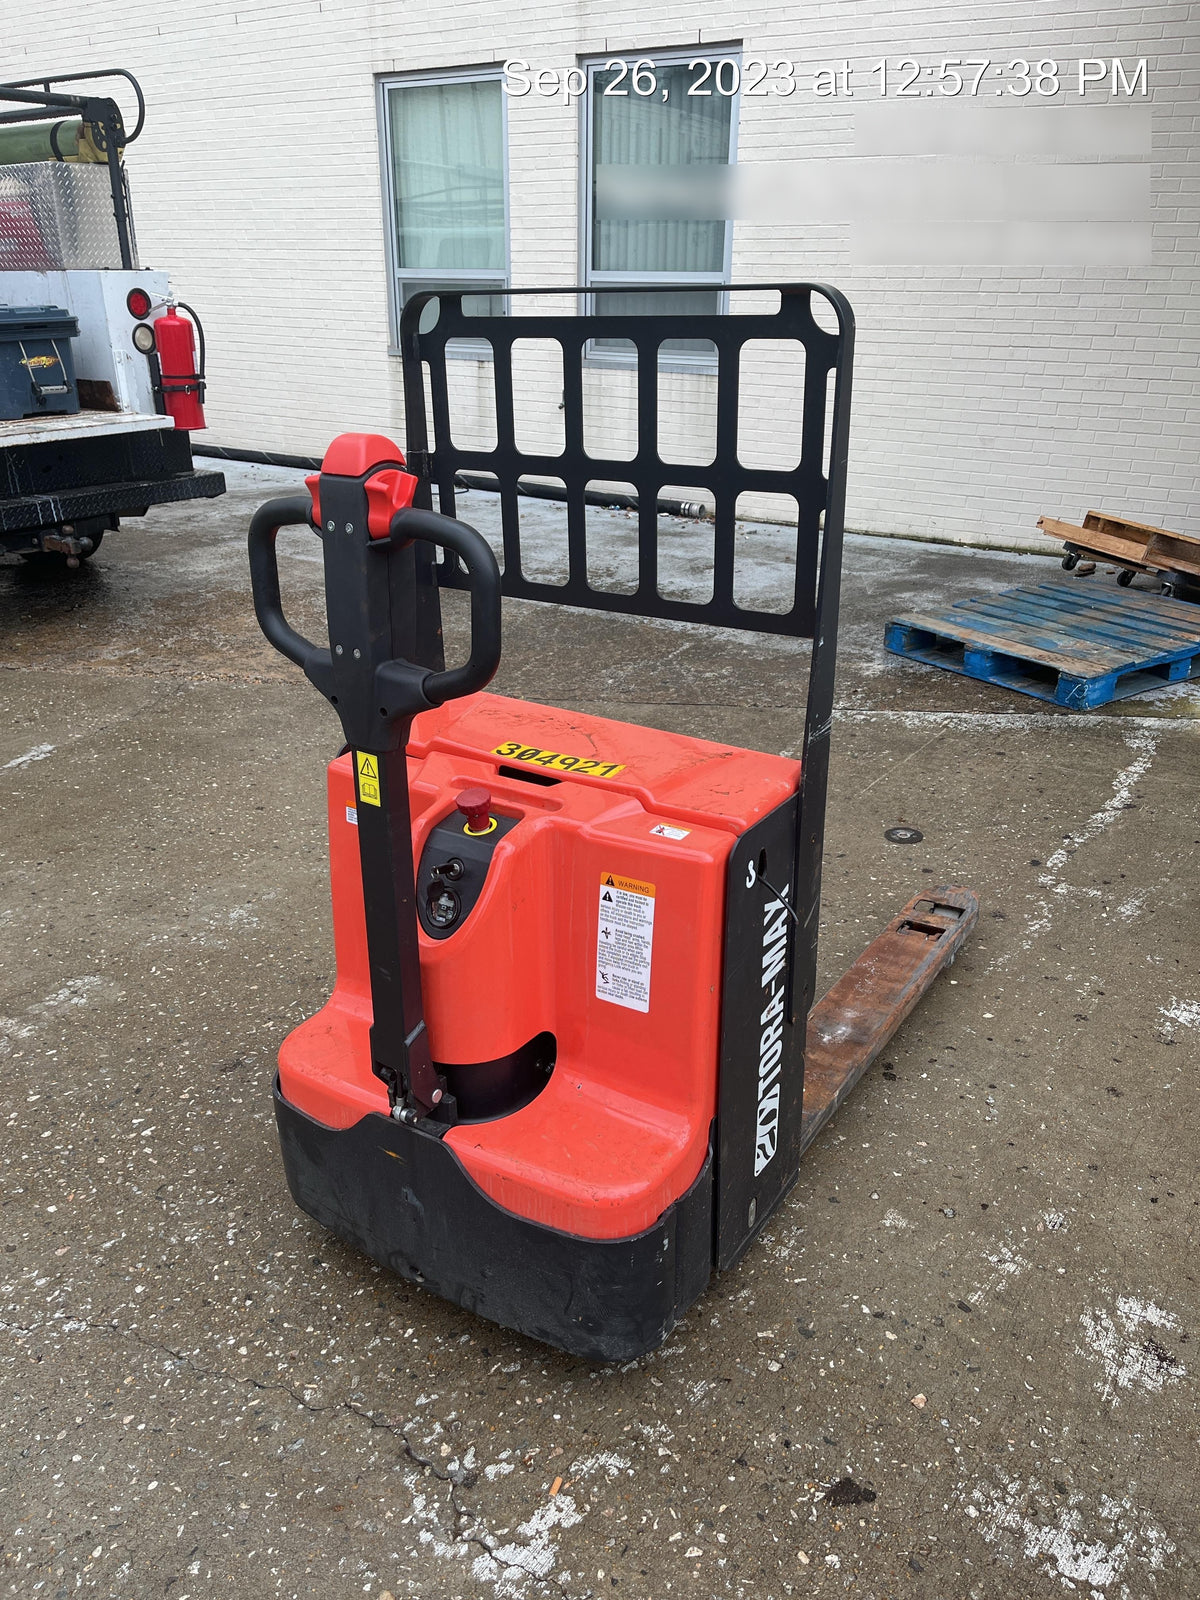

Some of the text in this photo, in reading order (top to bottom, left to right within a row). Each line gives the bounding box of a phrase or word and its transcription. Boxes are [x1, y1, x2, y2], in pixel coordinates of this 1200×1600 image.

[496, 743, 619, 777] 304921
[617, 880, 650, 894] WARNING
[757, 883, 790, 1102] TORA-MAX
